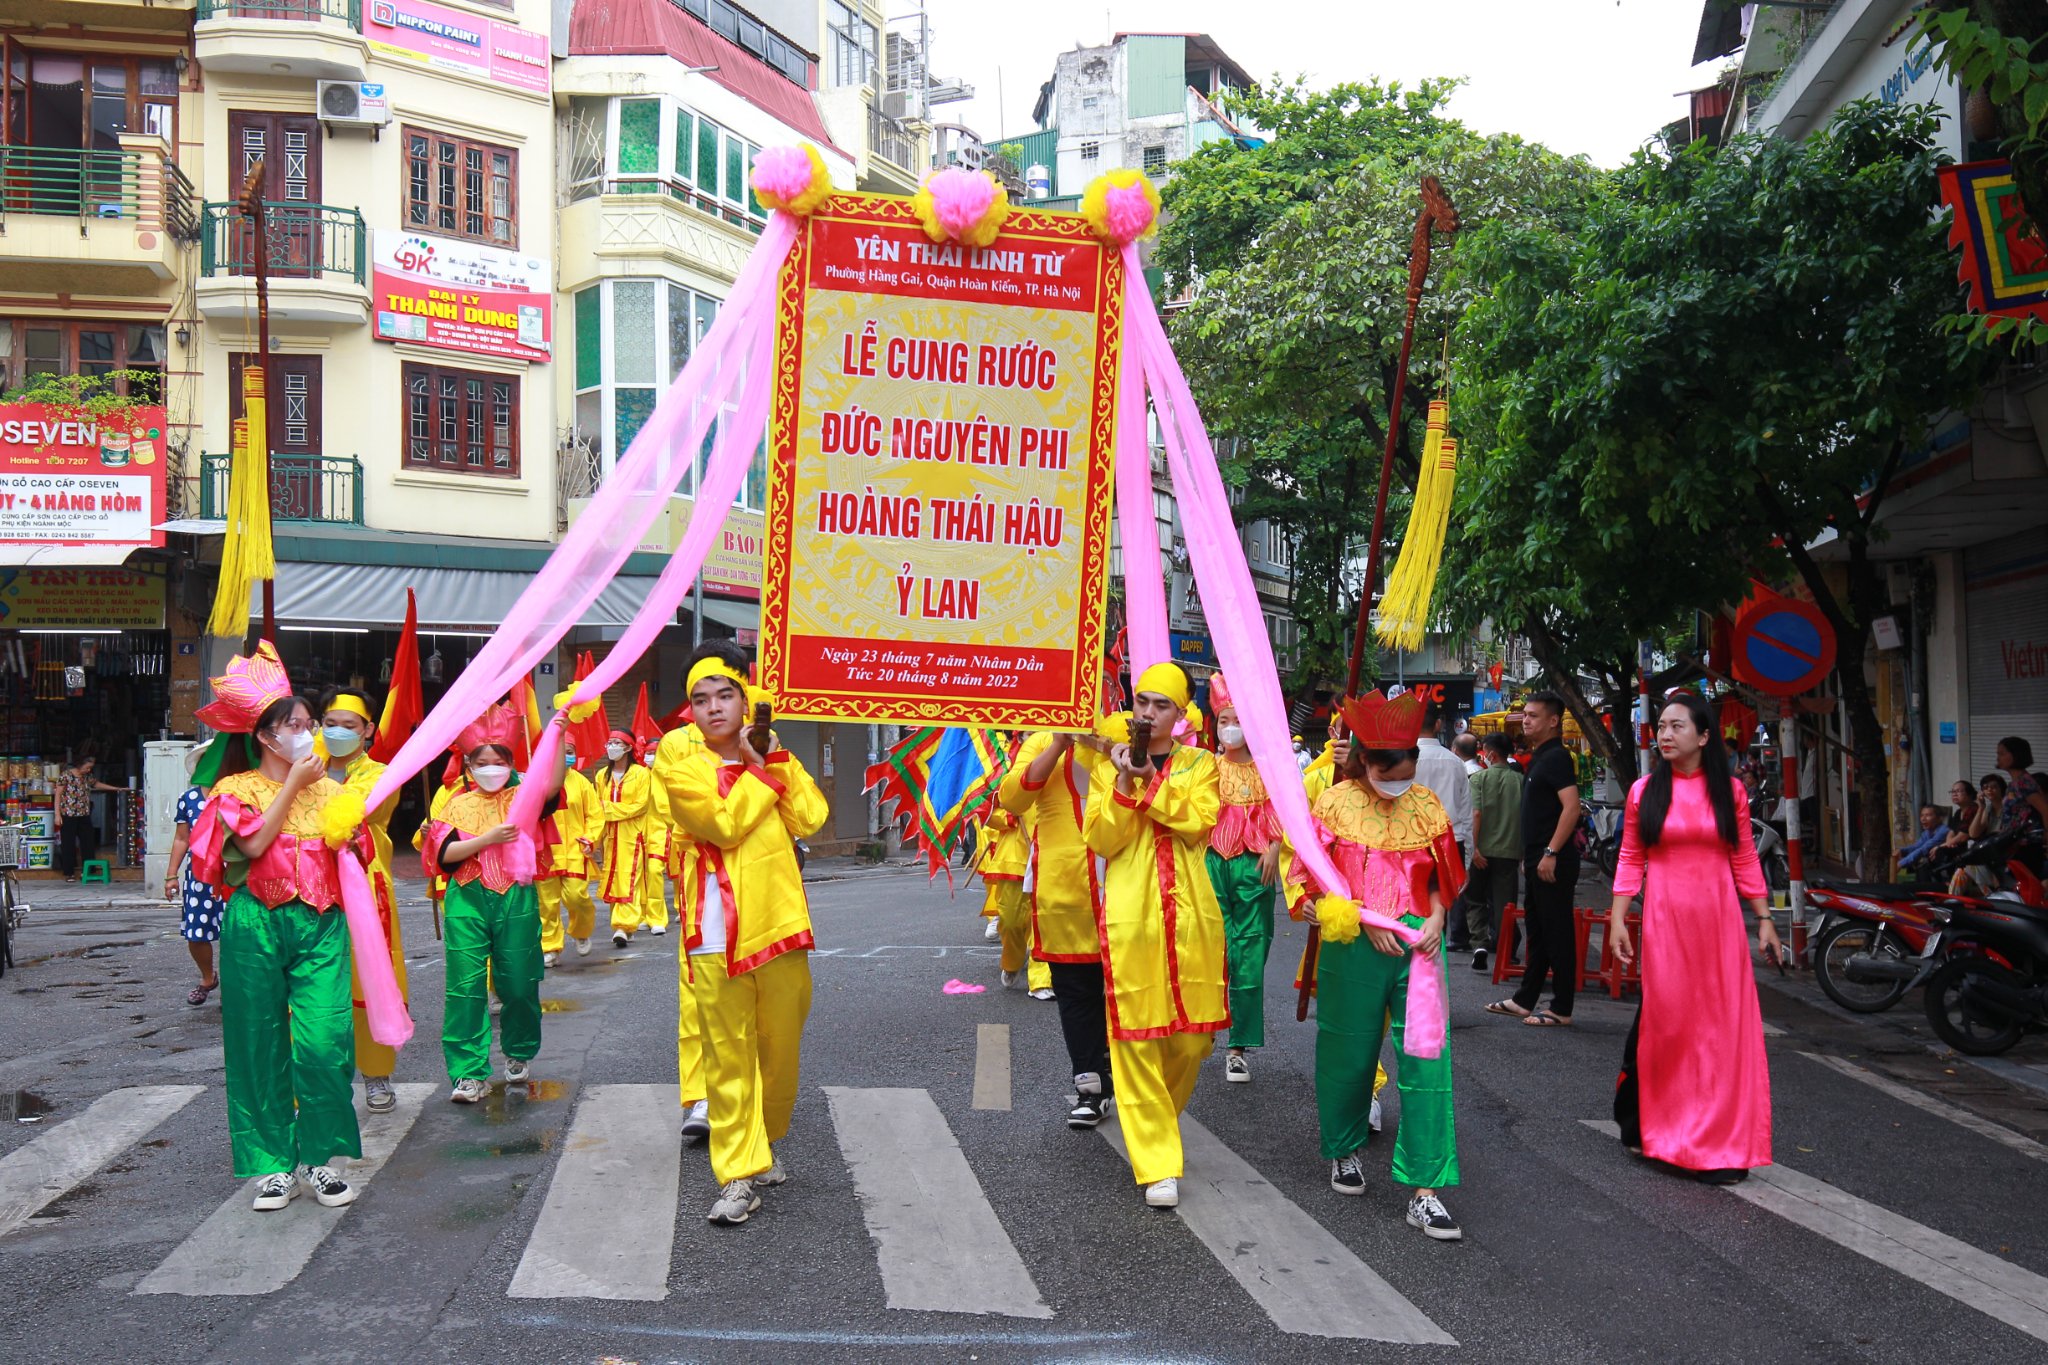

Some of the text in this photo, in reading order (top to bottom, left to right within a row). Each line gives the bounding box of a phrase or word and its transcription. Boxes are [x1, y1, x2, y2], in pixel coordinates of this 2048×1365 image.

[397, 13, 441, 34] NIPPON
[444, 24, 480, 44] PAINT
[494, 47, 547, 68] THANH DUNG
[855, 234, 1067, 276] YÊN THÁI LINH TỪ
[825, 265, 1081, 301] Phường Hàng Gai, Quận Hoàn Kiếm, TP. Hà Nội
[428, 289, 480, 306] ĐẠI LÝ
[387, 294, 518, 330] THANH DUNG
[843, 319, 1057, 391] LỄ CUNG RƯỚC
[0, 420, 96, 445] SEVEN
[821, 405, 1069, 470] ĐỨC NGUYÊN PHI
[12, 476, 27, 487] GỖ
[55, 478, 75, 488] CẤP
[79, 480, 119, 488] OSEVEN
[30, 495, 42, 510] 4
[44, 490, 96, 511] HÀNG
[101, 491, 142, 512] HÒM
[817, 486, 1064, 555] HOÀNG THÁI HẬU
[723, 527, 755, 555] BẢO
[896, 562, 980, 620] Ỷ LAN
[1181, 639, 1204, 653] DAPPER
[544, 665, 550, 673] 2
[820, 647, 1044, 672] Ngày 23 tháng 7 năm Nhâm Dần
[846, 667, 1018, 688] Tức 20 tháng 8 năm 2022
